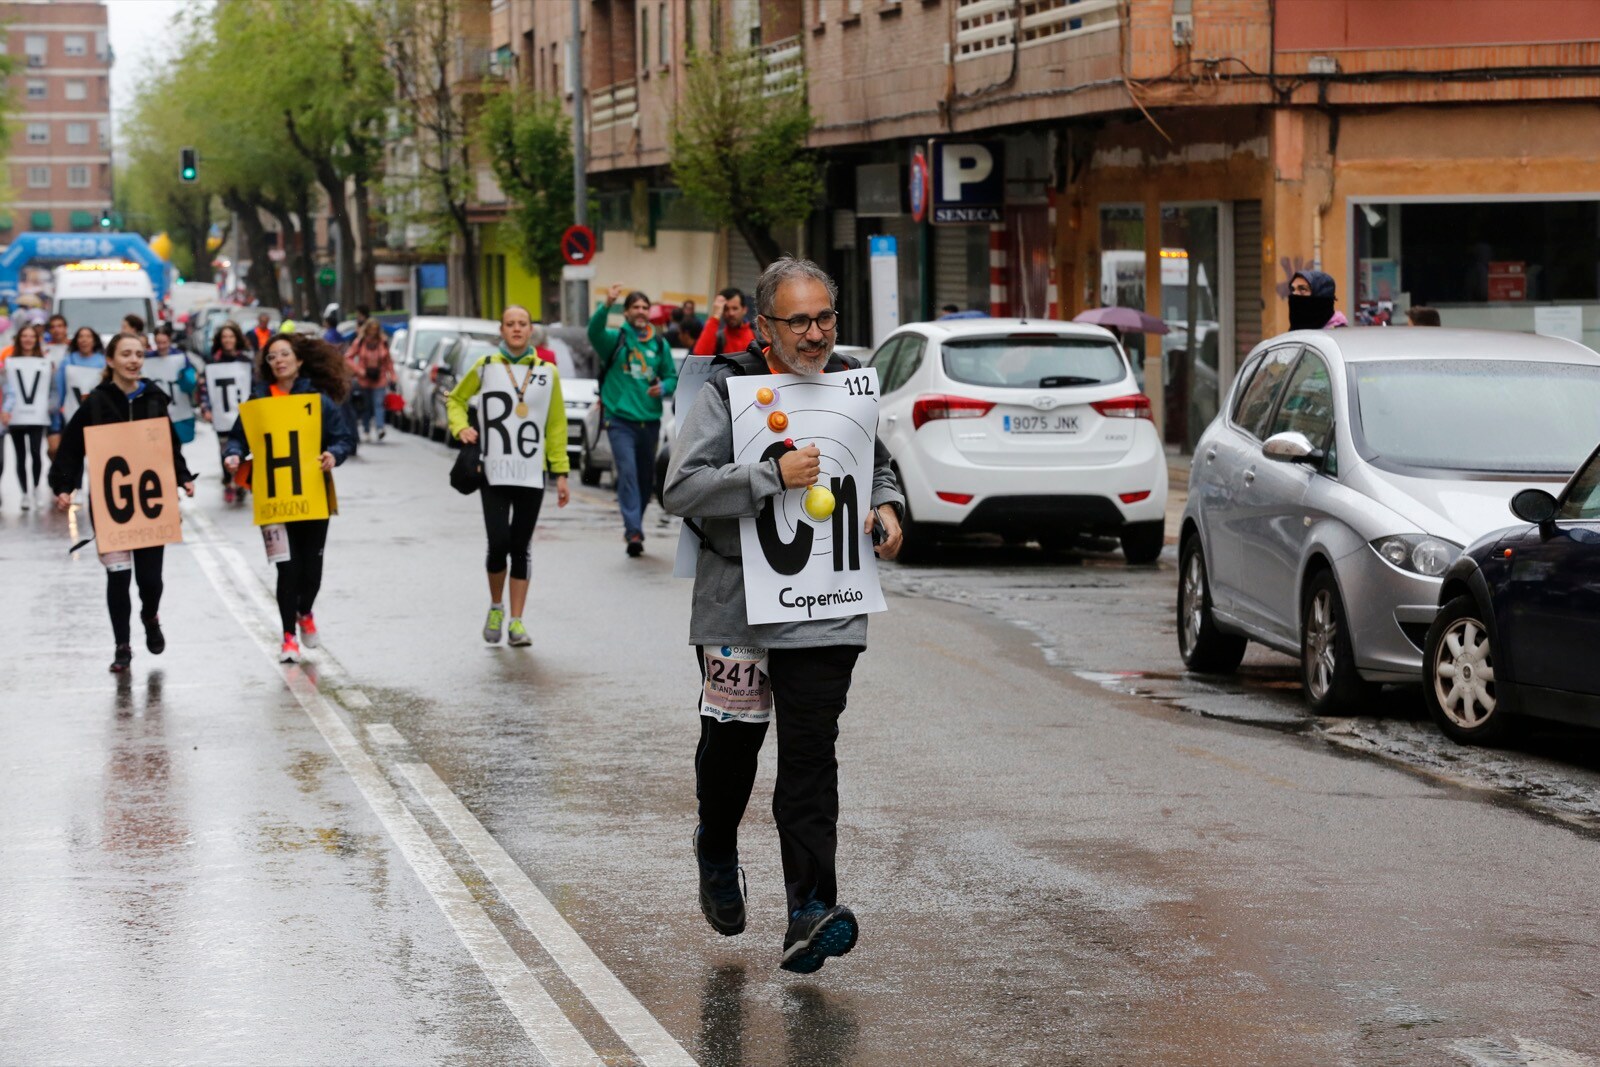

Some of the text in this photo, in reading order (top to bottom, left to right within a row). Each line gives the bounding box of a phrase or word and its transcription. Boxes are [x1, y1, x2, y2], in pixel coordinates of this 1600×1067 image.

[942, 143, 993, 201] P
[936, 209, 999, 221] SENECA
[16, 369, 41, 405] V
[530, 374, 547, 386] 75
[844, 375, 874, 396] 112
[304, 403, 312, 416] 1
[482, 391, 540, 458] Re
[1013, 416, 1079, 430] 9075 JNK
[263, 430, 303, 498] H
[103, 456, 164, 524] Ge
[756, 440, 860, 576] Cn
[779, 587, 863, 618] Copernicio
